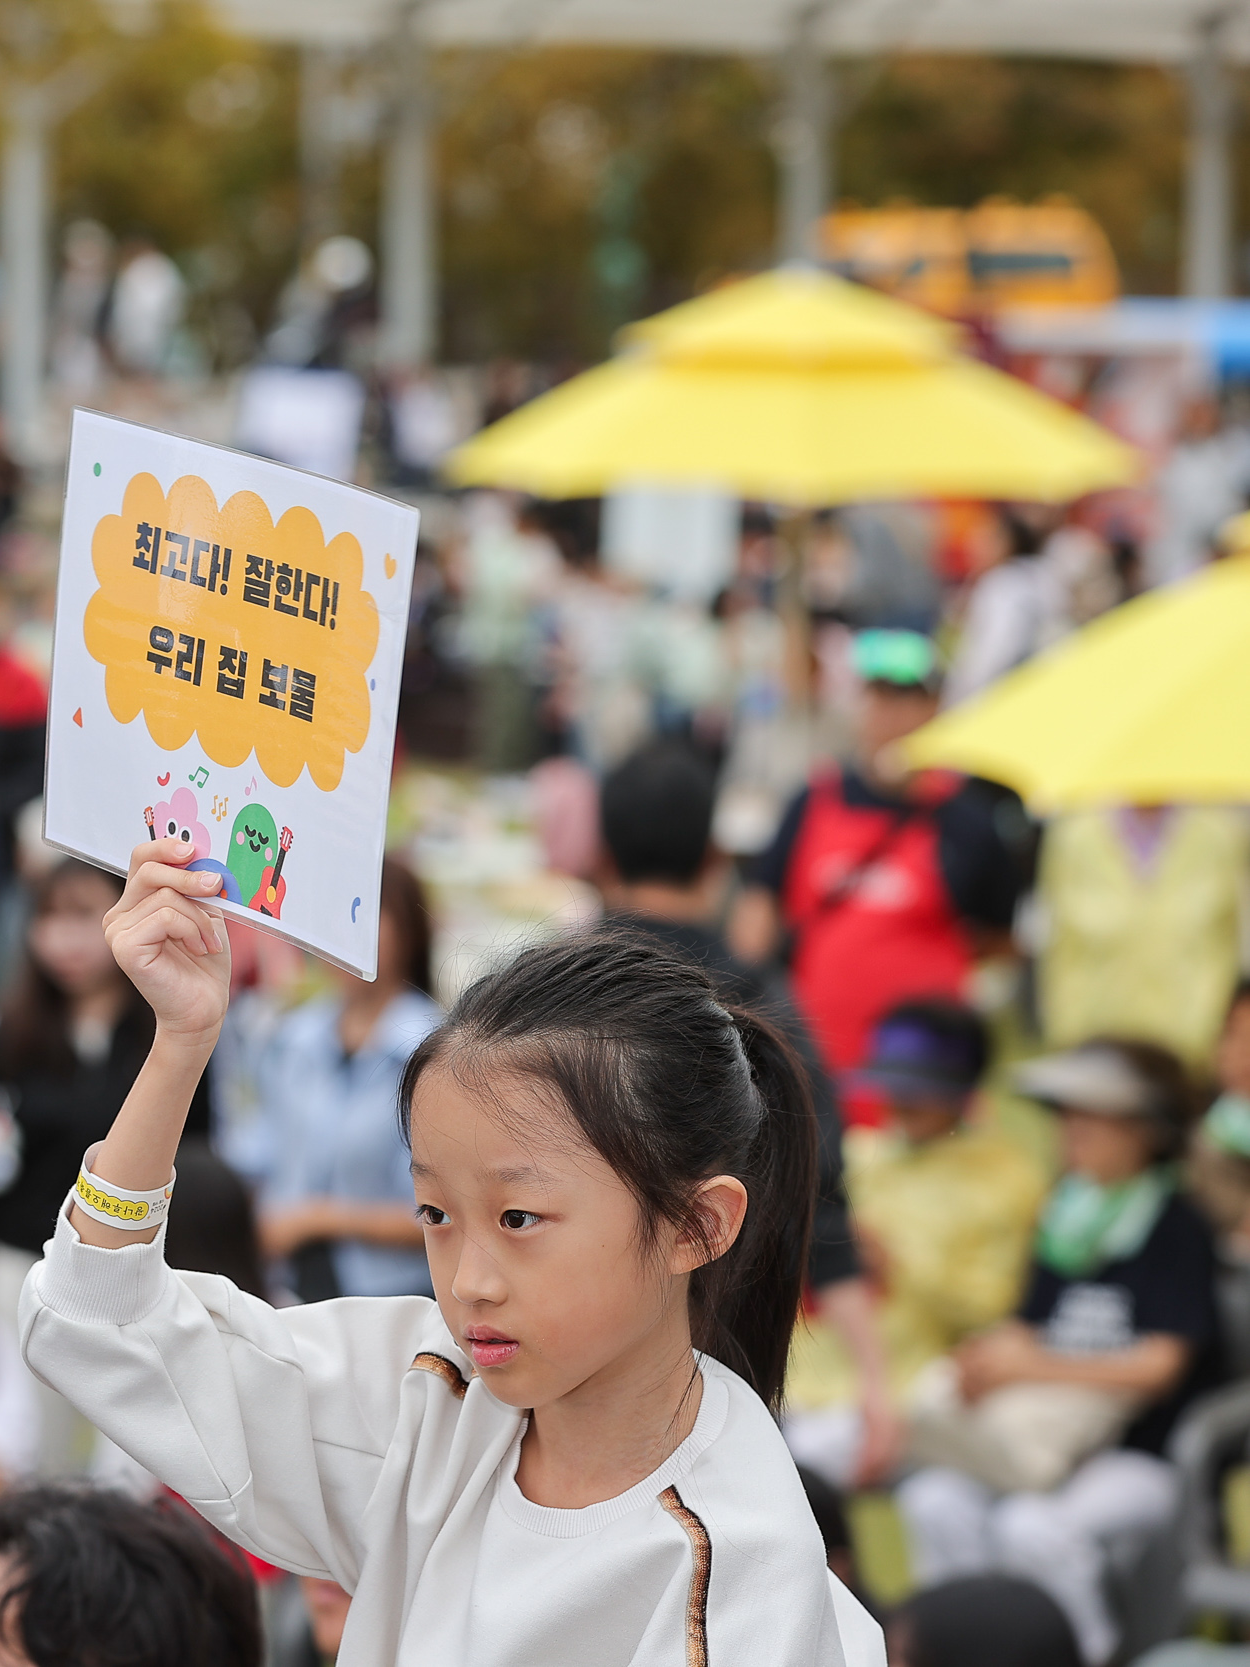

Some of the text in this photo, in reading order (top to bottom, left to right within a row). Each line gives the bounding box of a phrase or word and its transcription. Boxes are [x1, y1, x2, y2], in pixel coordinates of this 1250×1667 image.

[132, 521, 340, 630] 최고다! 잘한다!
[146, 625, 317, 723] 우리 집 보물
